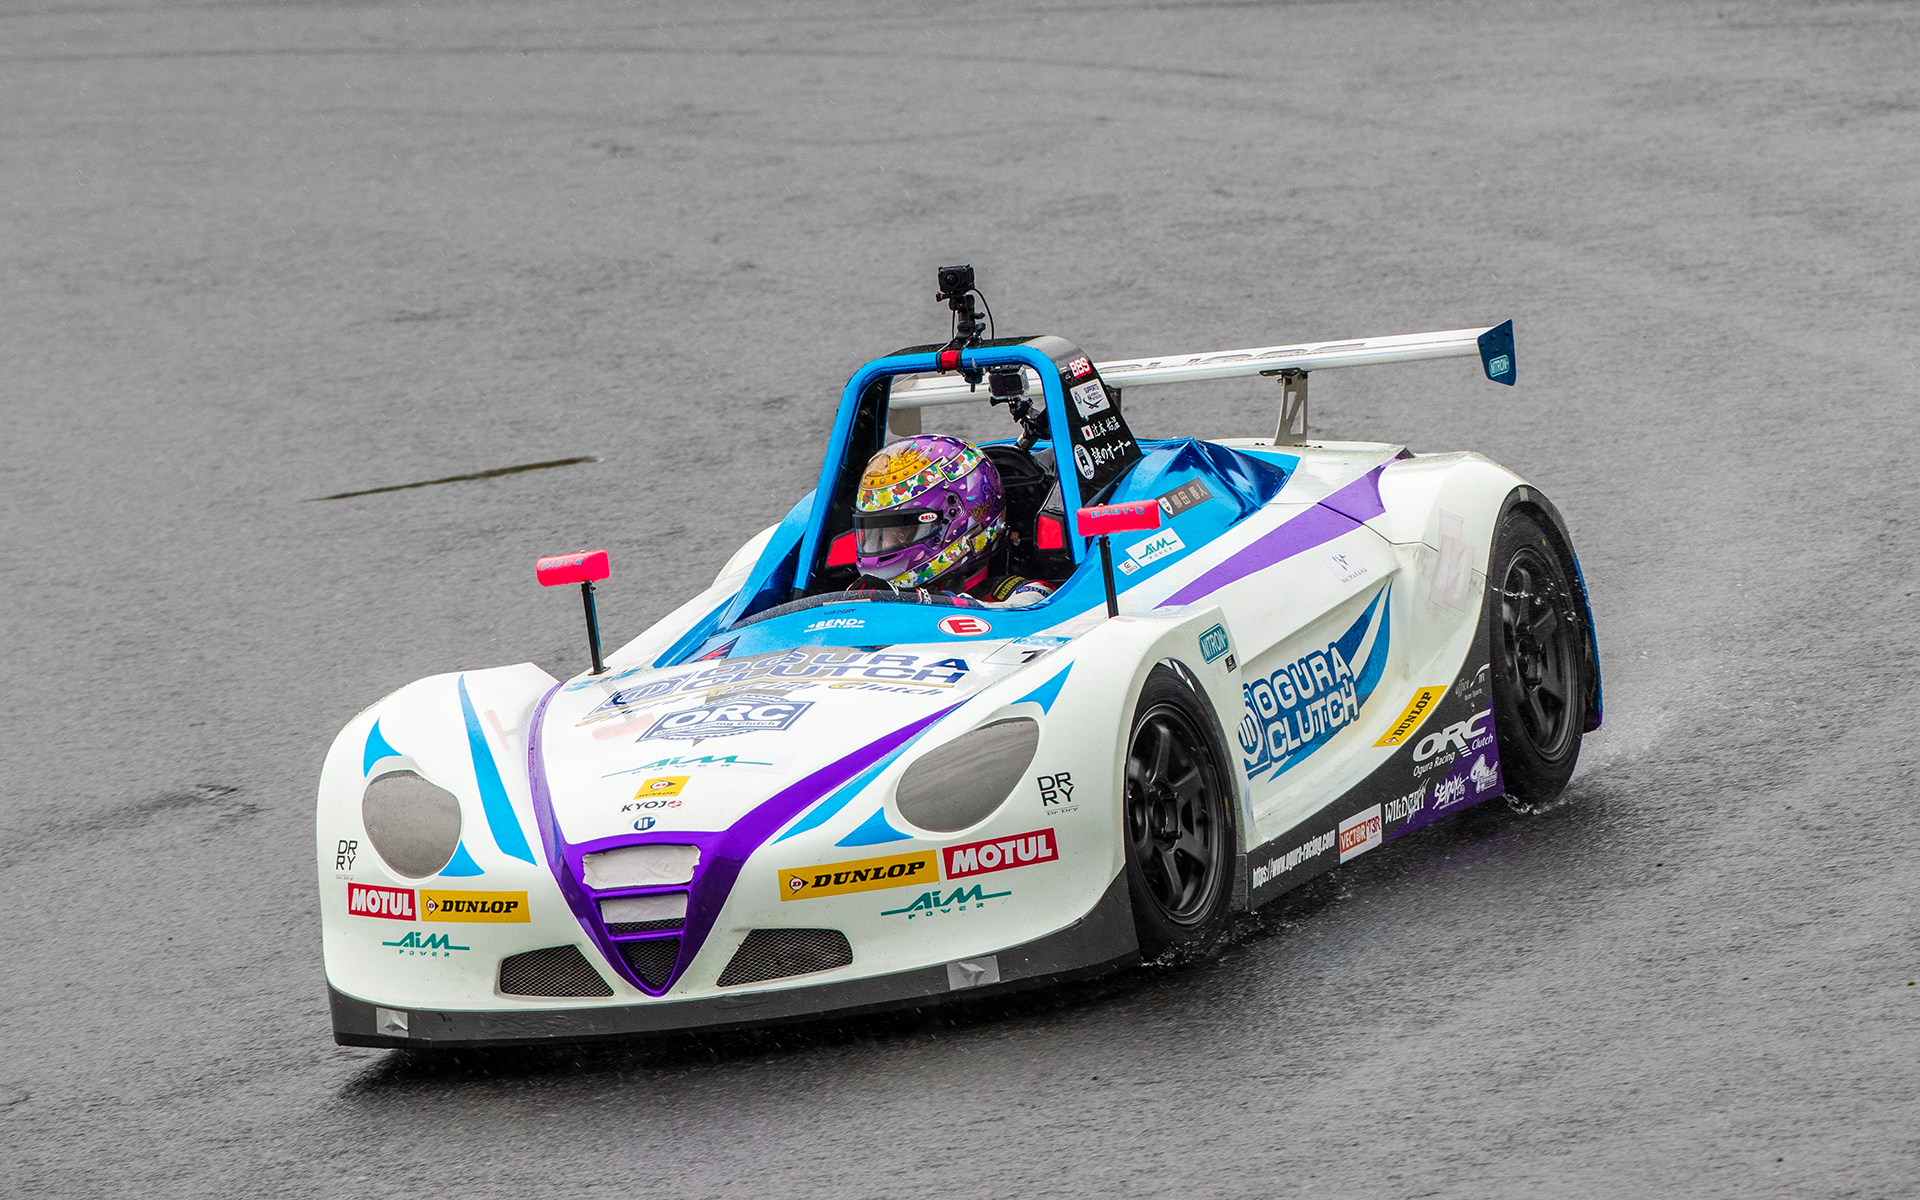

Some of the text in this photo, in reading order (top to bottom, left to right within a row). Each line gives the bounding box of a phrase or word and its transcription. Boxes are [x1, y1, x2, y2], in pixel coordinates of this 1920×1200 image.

[1069, 356, 1091, 379] BBS
[1091, 506, 1145, 518] BABY-G
[814, 618, 858, 629] BEND
[946, 619, 982, 634] E
[1200, 628, 1227, 659] NITRON
[681, 663, 967, 691] CLUTCH
[1253, 646, 1352, 720] OGURA
[661, 704, 797, 729] ORC
[1267, 678, 1360, 759] CLUTCH
[1392, 691, 1432, 737] DUNLOP
[1412, 708, 1492, 763] ORC
[1413, 732, 1494, 778] Ogura Racing Clutch
[1037, 771, 1074, 792] DR
[1041, 786, 1075, 807] RY
[338, 839, 358, 855] DR
[950, 834, 1053, 875] MOTUL
[335, 855, 356, 871] RY
[811, 861, 926, 889] DUNLOP
[351, 887, 413, 917] MOTUL
[440, 900, 519, 914] DUNLOP
[908, 902, 984, 919] POWER
